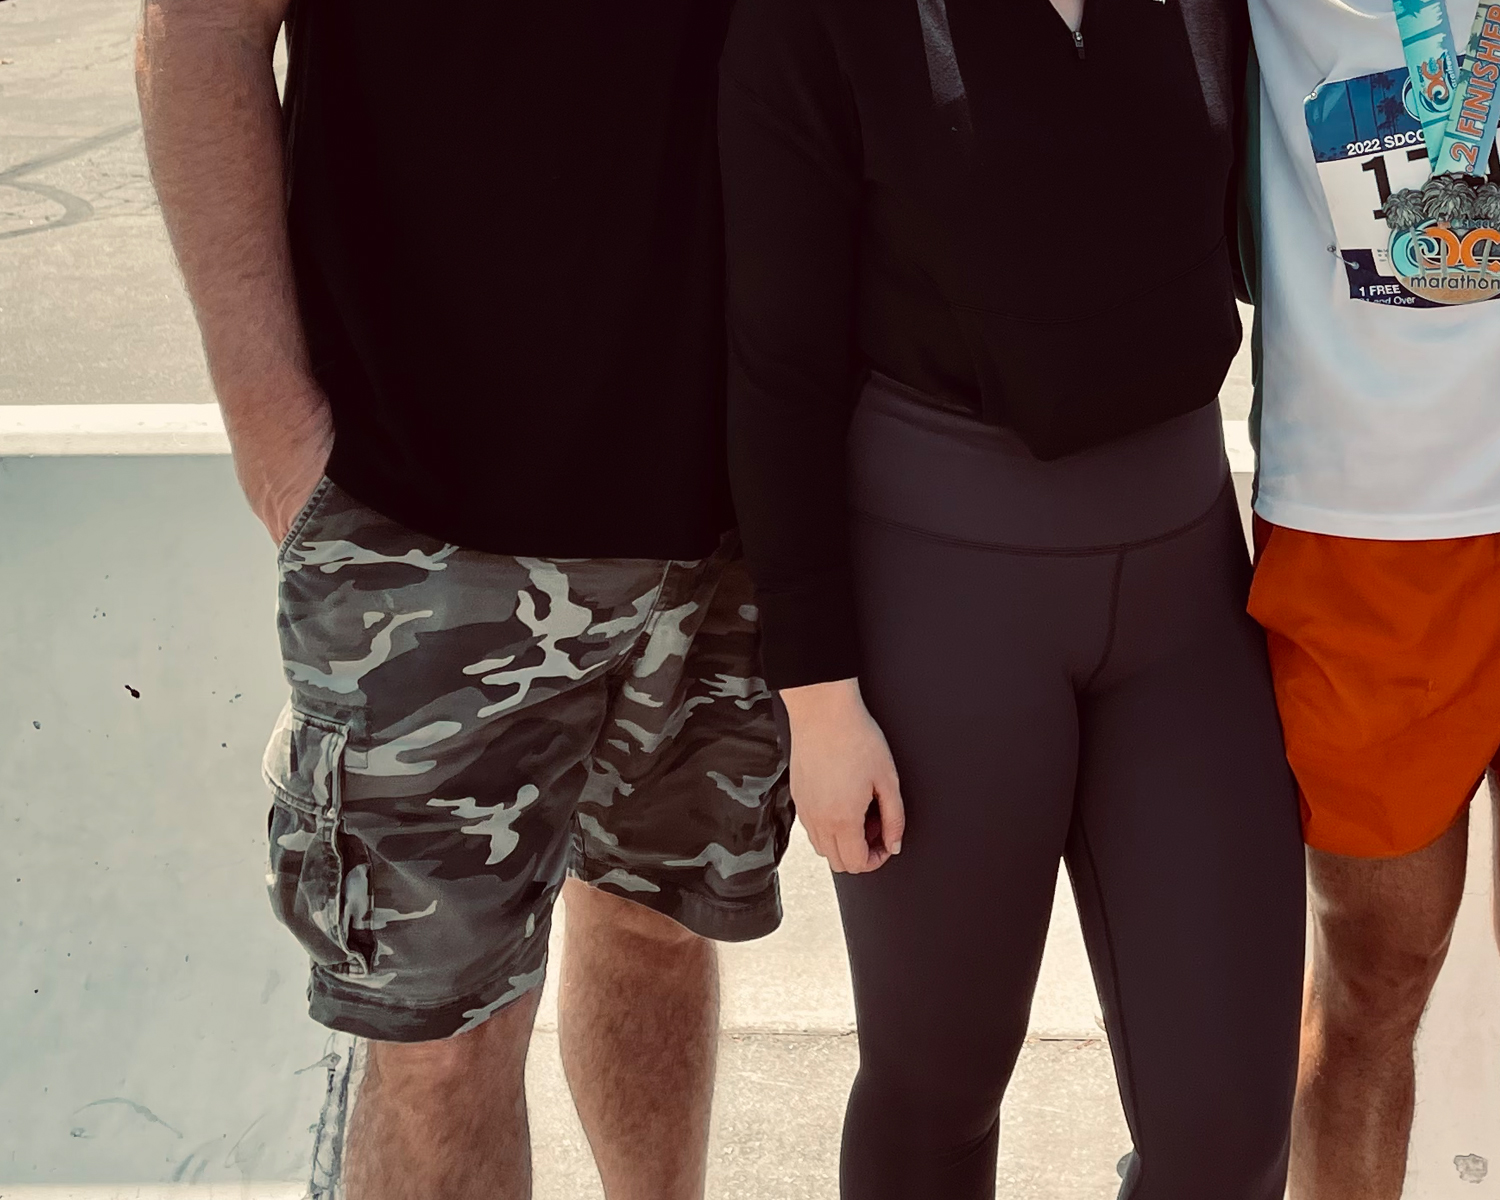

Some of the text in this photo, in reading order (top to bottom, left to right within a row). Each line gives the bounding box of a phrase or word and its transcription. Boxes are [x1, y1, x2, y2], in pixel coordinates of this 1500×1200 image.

[1346, 140, 1382, 156] 2022
[1384, 129, 1424, 149] SDCC
[1410, 274, 1500, 290] marathon
[1359, 284, 1401, 297] 1 FREE
[1393, 296, 1416, 305] Over
